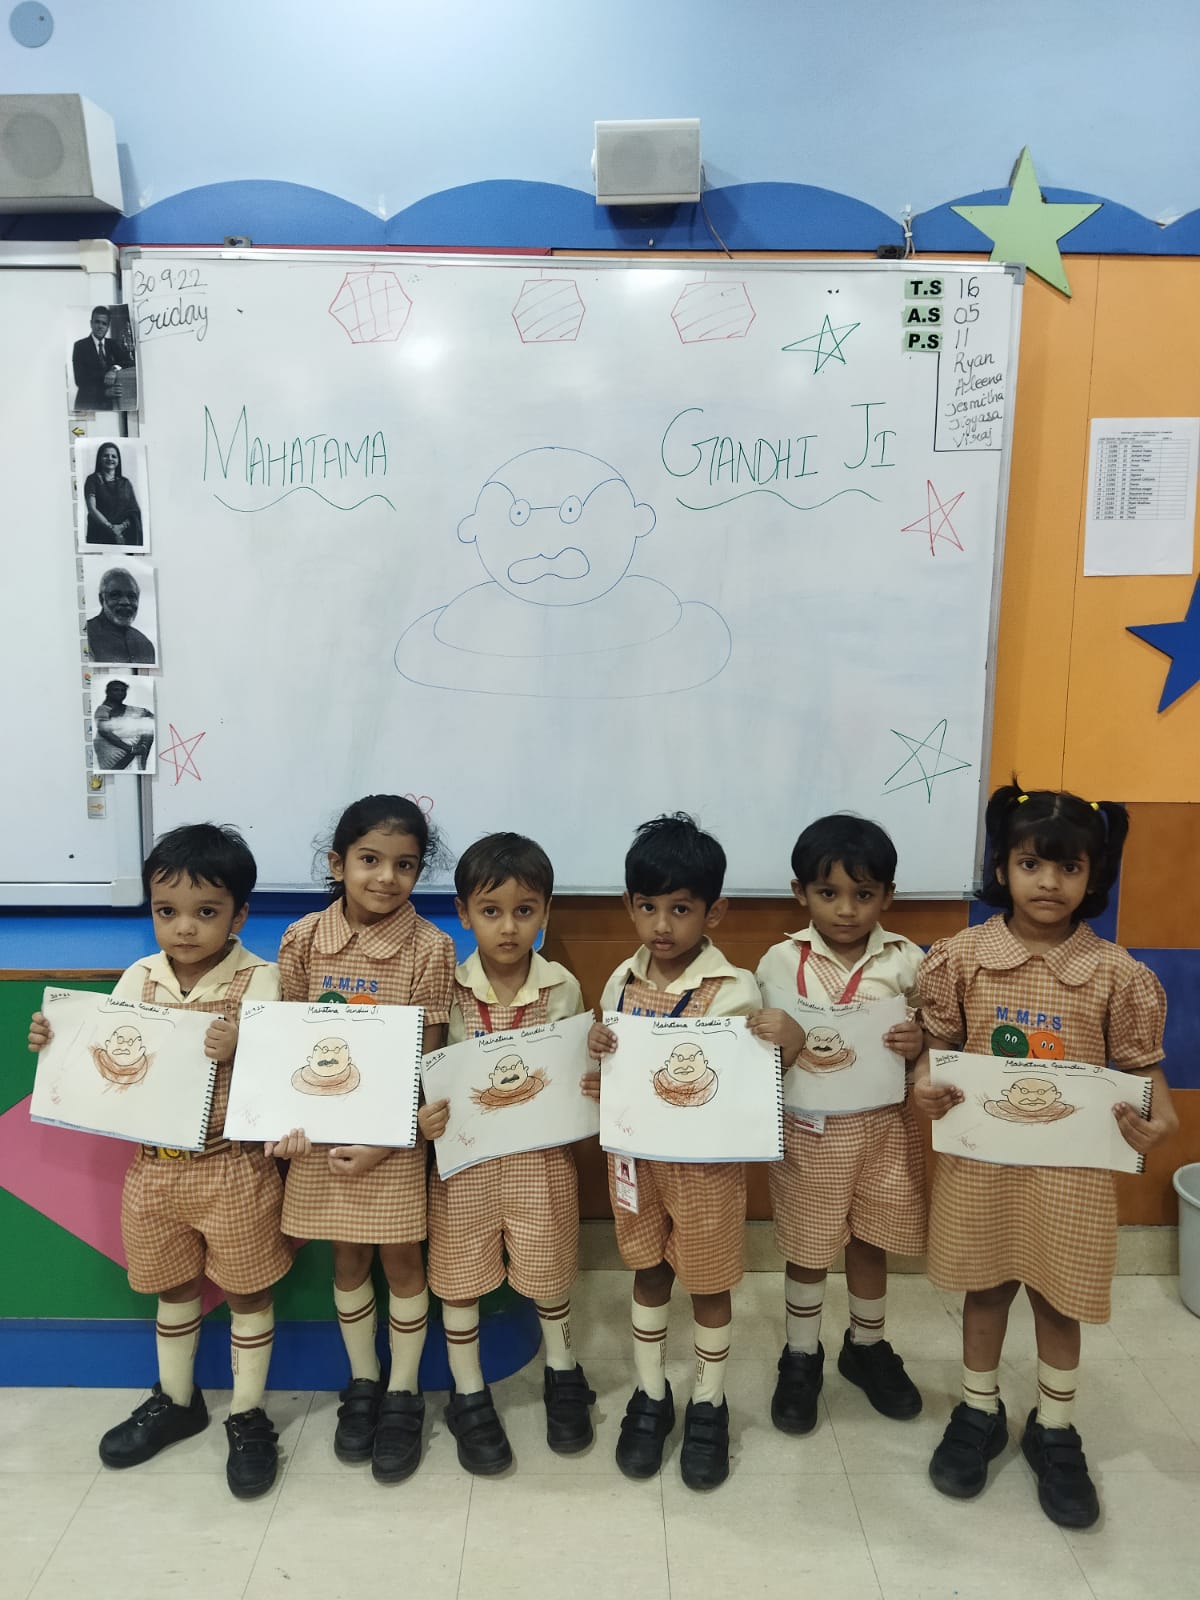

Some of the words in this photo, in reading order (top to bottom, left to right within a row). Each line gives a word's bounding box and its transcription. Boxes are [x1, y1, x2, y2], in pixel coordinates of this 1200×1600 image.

[910, 279, 942, 296] T.S
[959, 276, 980, 299] 16
[135, 298, 209, 342] Friday
[907, 307, 941, 323] A.S
[953, 303, 980, 325] 05
[908, 333, 940, 349] P.S
[955, 327, 969, 349] 11
[953, 351, 995, 380] Ryan
[203, 404, 388, 487] MAHATAMA
[661, 407, 818, 486] GANDHI
[843, 402, 896, 469] JI
[322, 975, 379, 993] M.M.P.S
[996, 1006, 1062, 1031] M.M.P.S
